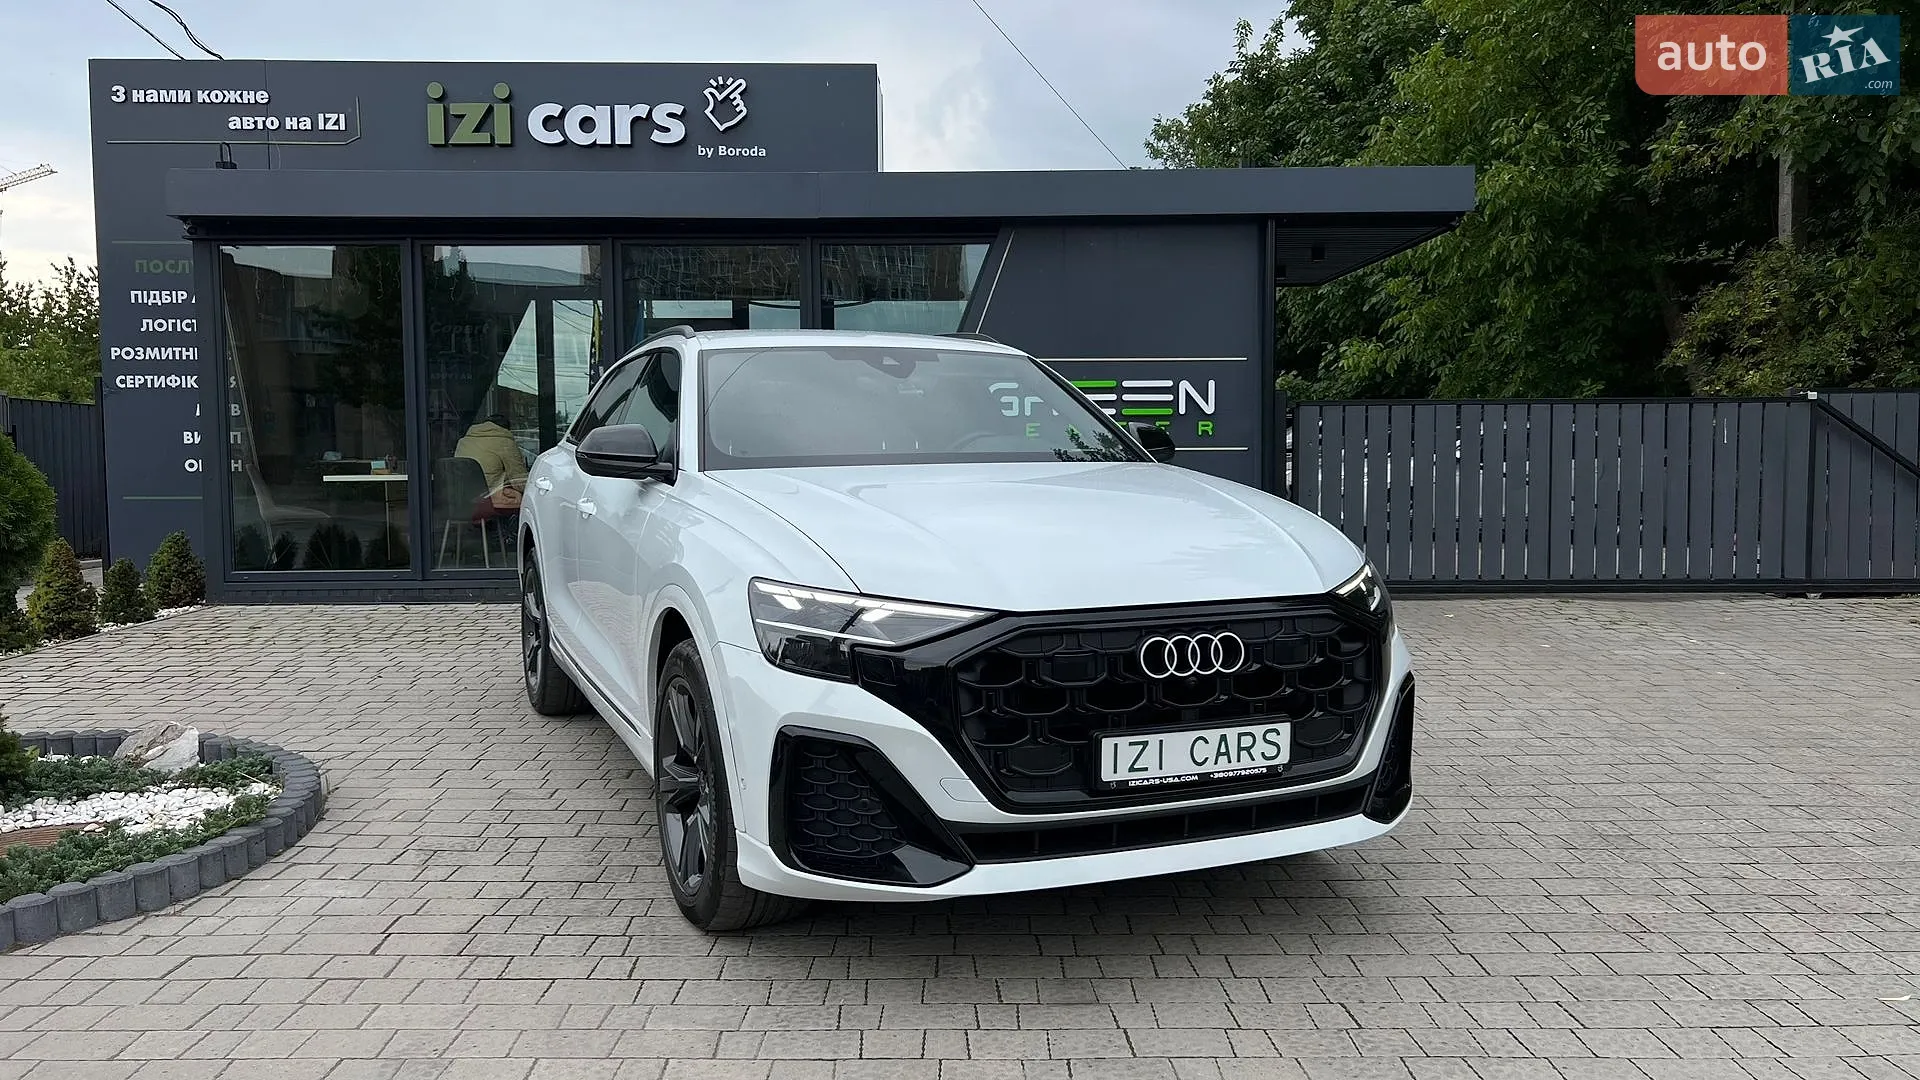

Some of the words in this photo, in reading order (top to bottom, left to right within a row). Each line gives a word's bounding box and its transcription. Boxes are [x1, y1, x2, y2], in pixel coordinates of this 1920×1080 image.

[133, 88, 190, 102] нами
[197, 89, 269, 104] кожне
[427, 82, 514, 145] izi
[527, 102, 687, 145] cars
[228, 115, 278, 130] авто
[285, 115, 312, 130] на
[698, 145, 713, 158] by
[719, 146, 766, 157] Boroda
[130, 290, 188, 305] ПІДБІР
[1112, 739, 1164, 774] IZI
[1189, 728, 1281, 767] CARS
